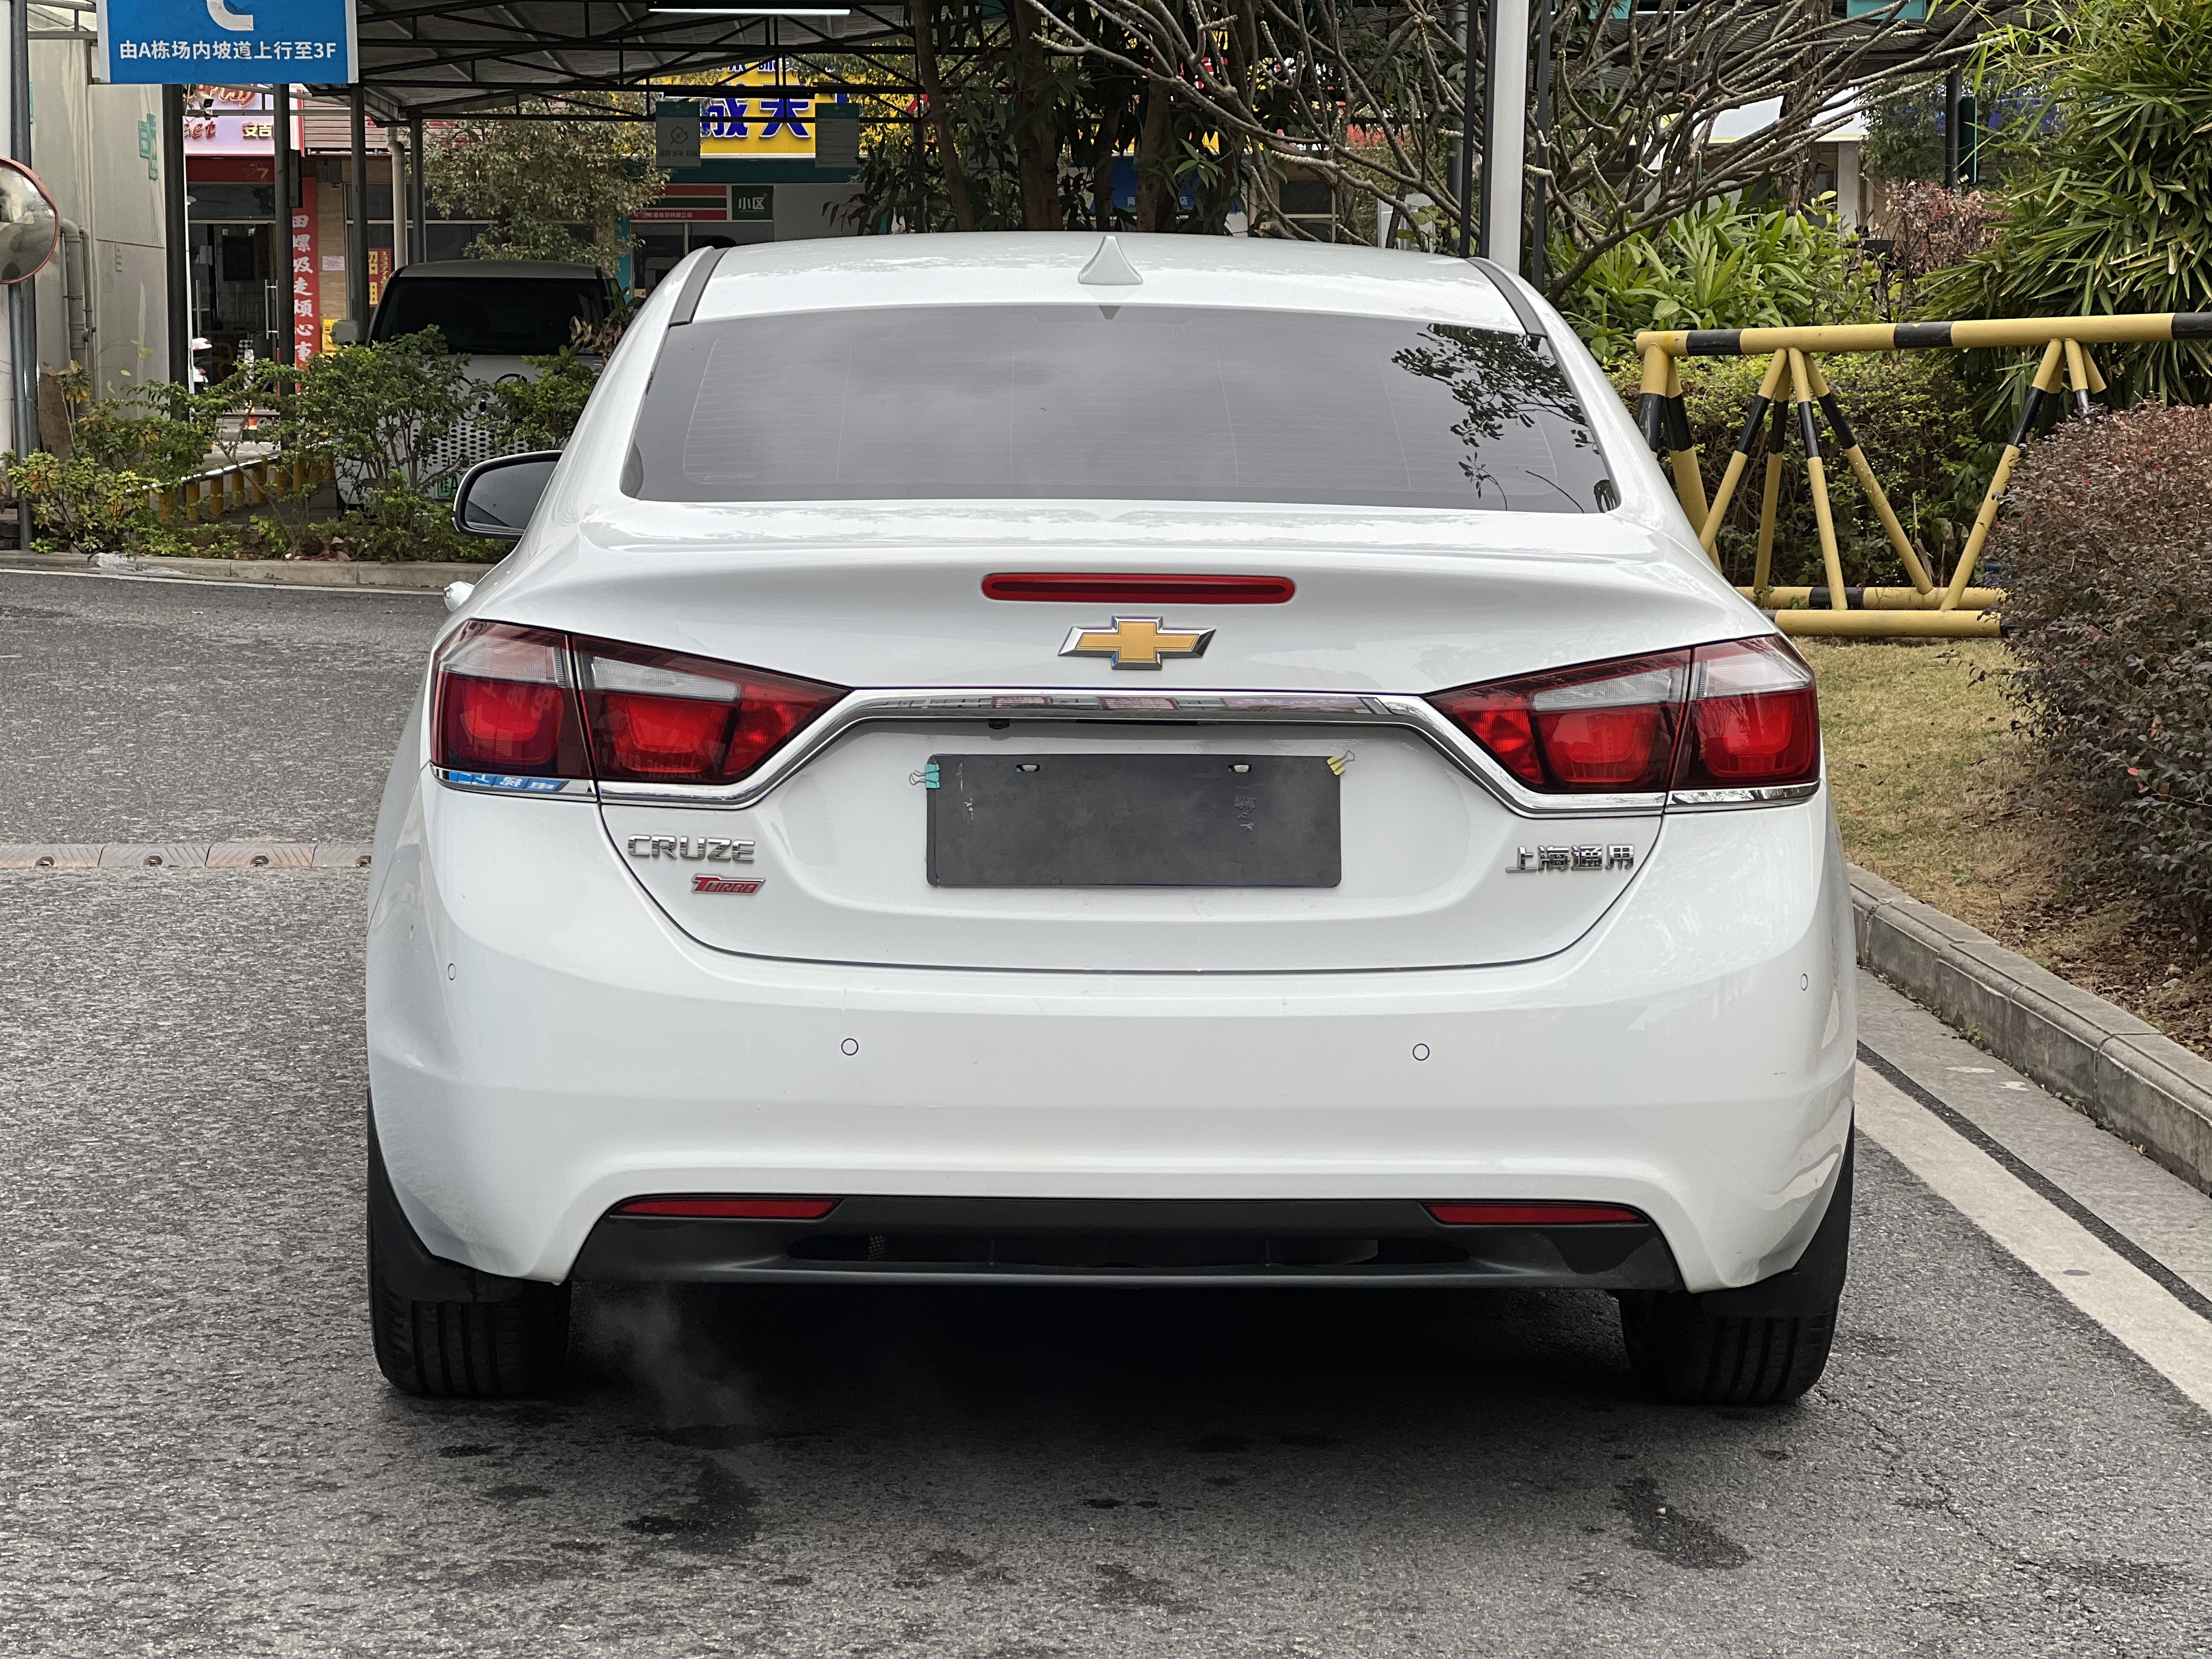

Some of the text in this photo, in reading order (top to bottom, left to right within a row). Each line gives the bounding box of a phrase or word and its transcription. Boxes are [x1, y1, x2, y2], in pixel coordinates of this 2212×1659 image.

[119, 40, 336, 60] 由A栋场内坡道上行至3F
[738, 197, 765, 210] 小区
[627, 834, 755, 864] CRUZE
[1505, 843, 1635, 873] 上海通用
